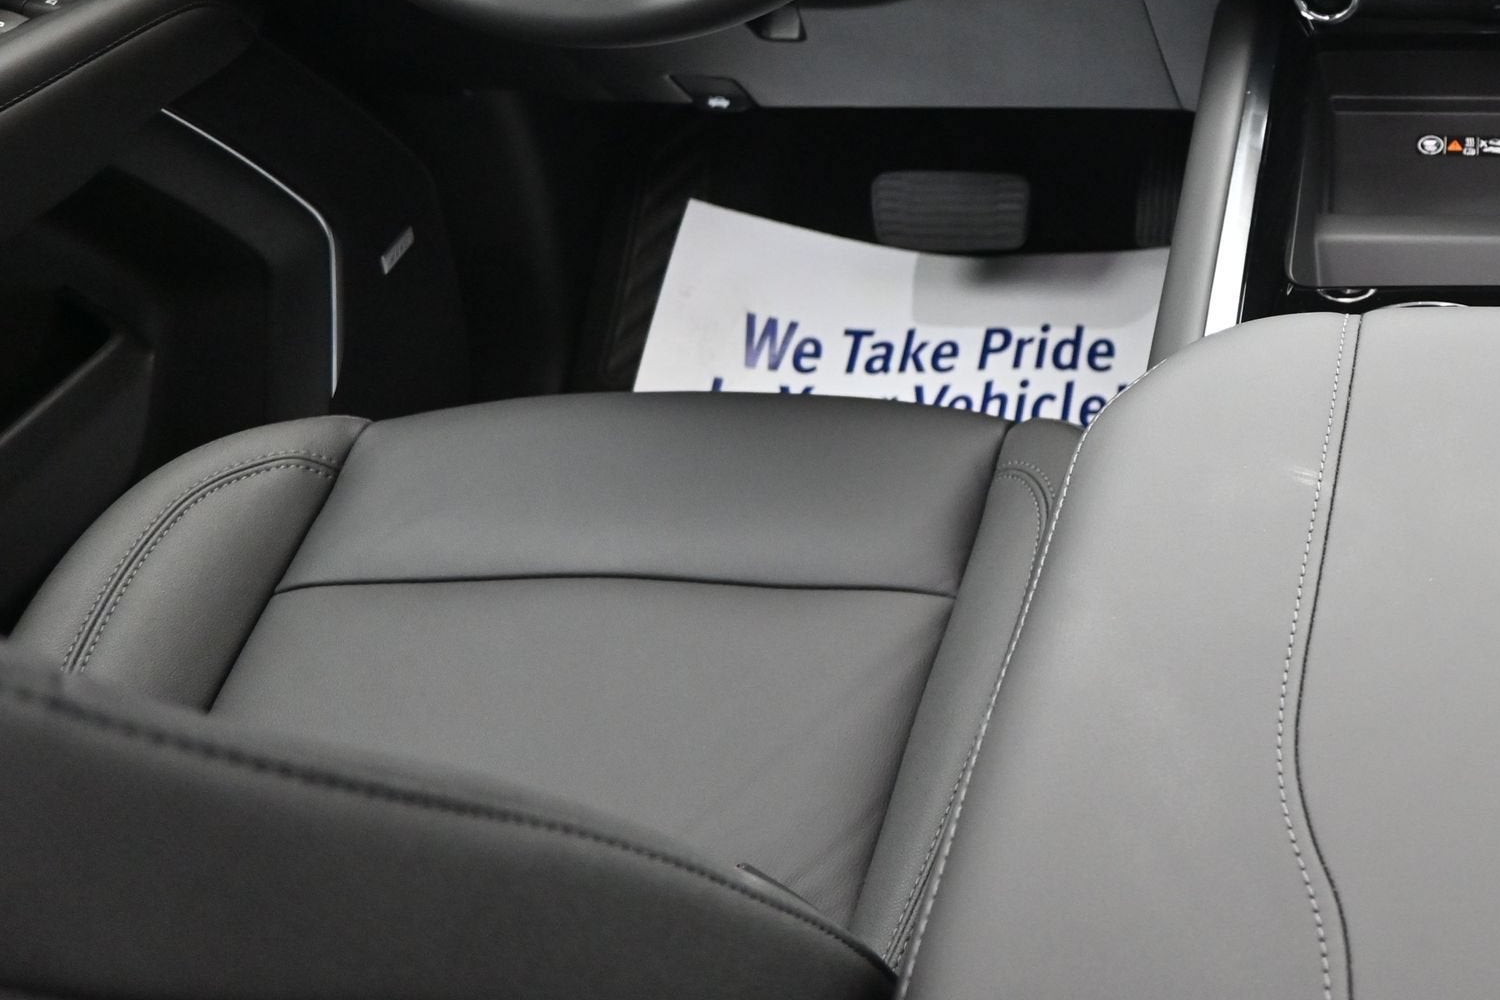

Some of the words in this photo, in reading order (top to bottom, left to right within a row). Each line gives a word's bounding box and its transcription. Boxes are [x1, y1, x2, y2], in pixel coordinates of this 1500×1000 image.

[743, 311, 823, 373] We
[842, 327, 960, 375] Take
[977, 323, 1117, 373] Pride
